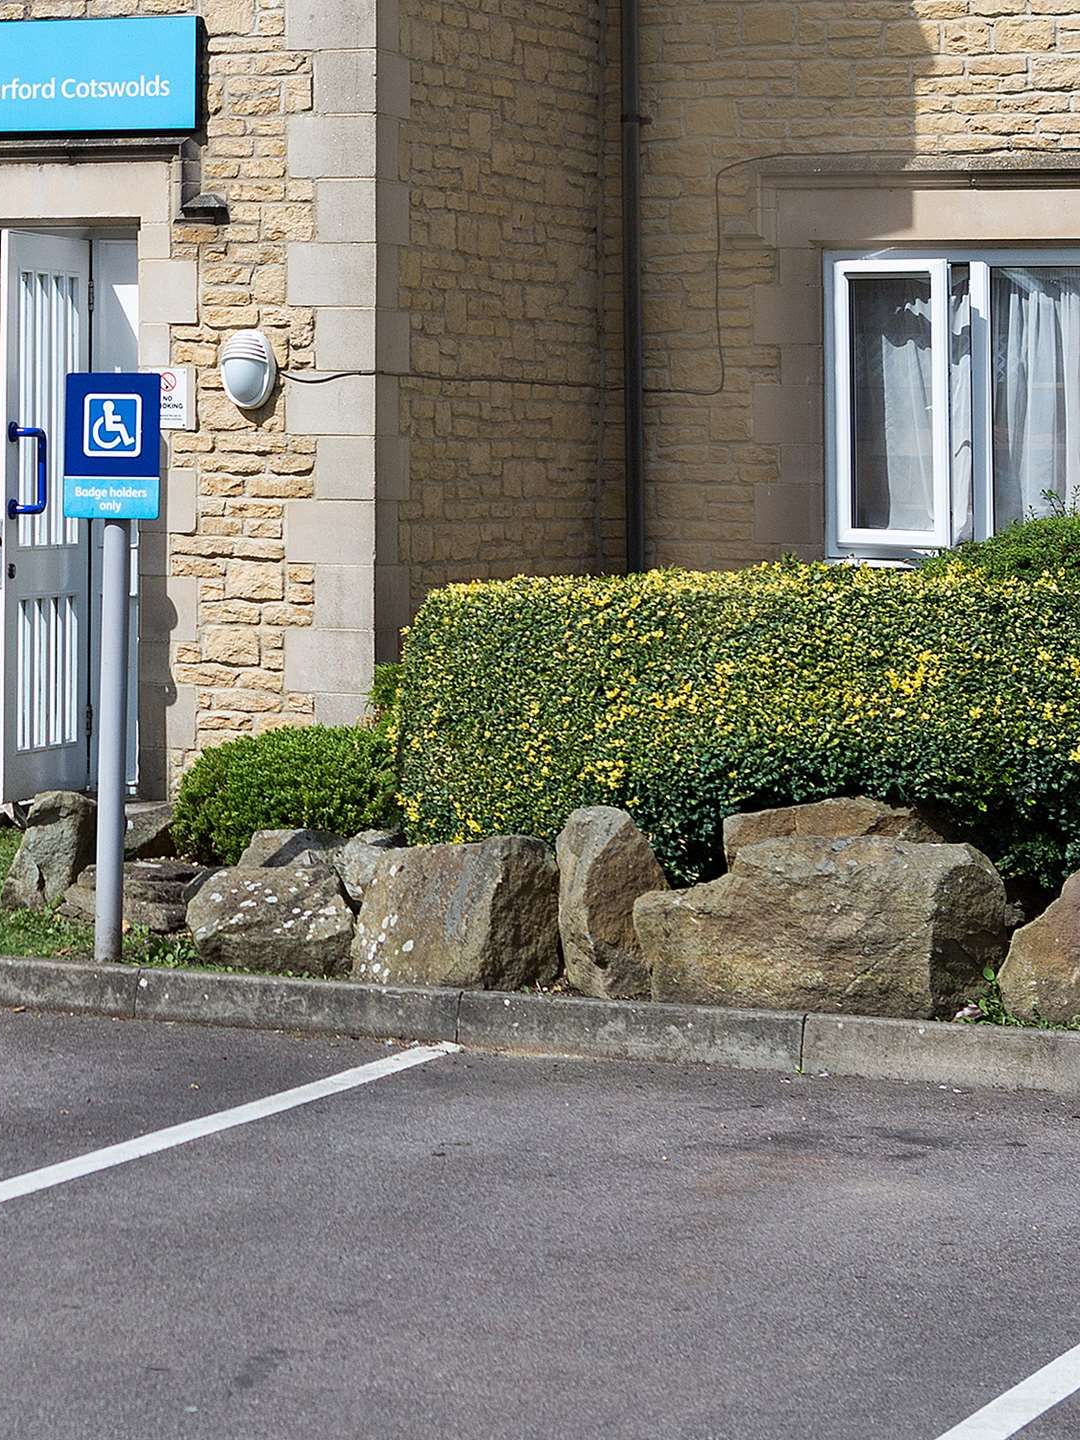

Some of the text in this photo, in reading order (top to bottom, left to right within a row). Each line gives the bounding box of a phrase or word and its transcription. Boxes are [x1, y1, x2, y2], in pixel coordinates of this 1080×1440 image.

[60, 74, 171, 100] Cotswolds
[163, 395, 173, 403] NO
[160, 402, 184, 410] OKING
[75, 486, 148, 500] Badge holders
[99, 499, 122, 512] only
